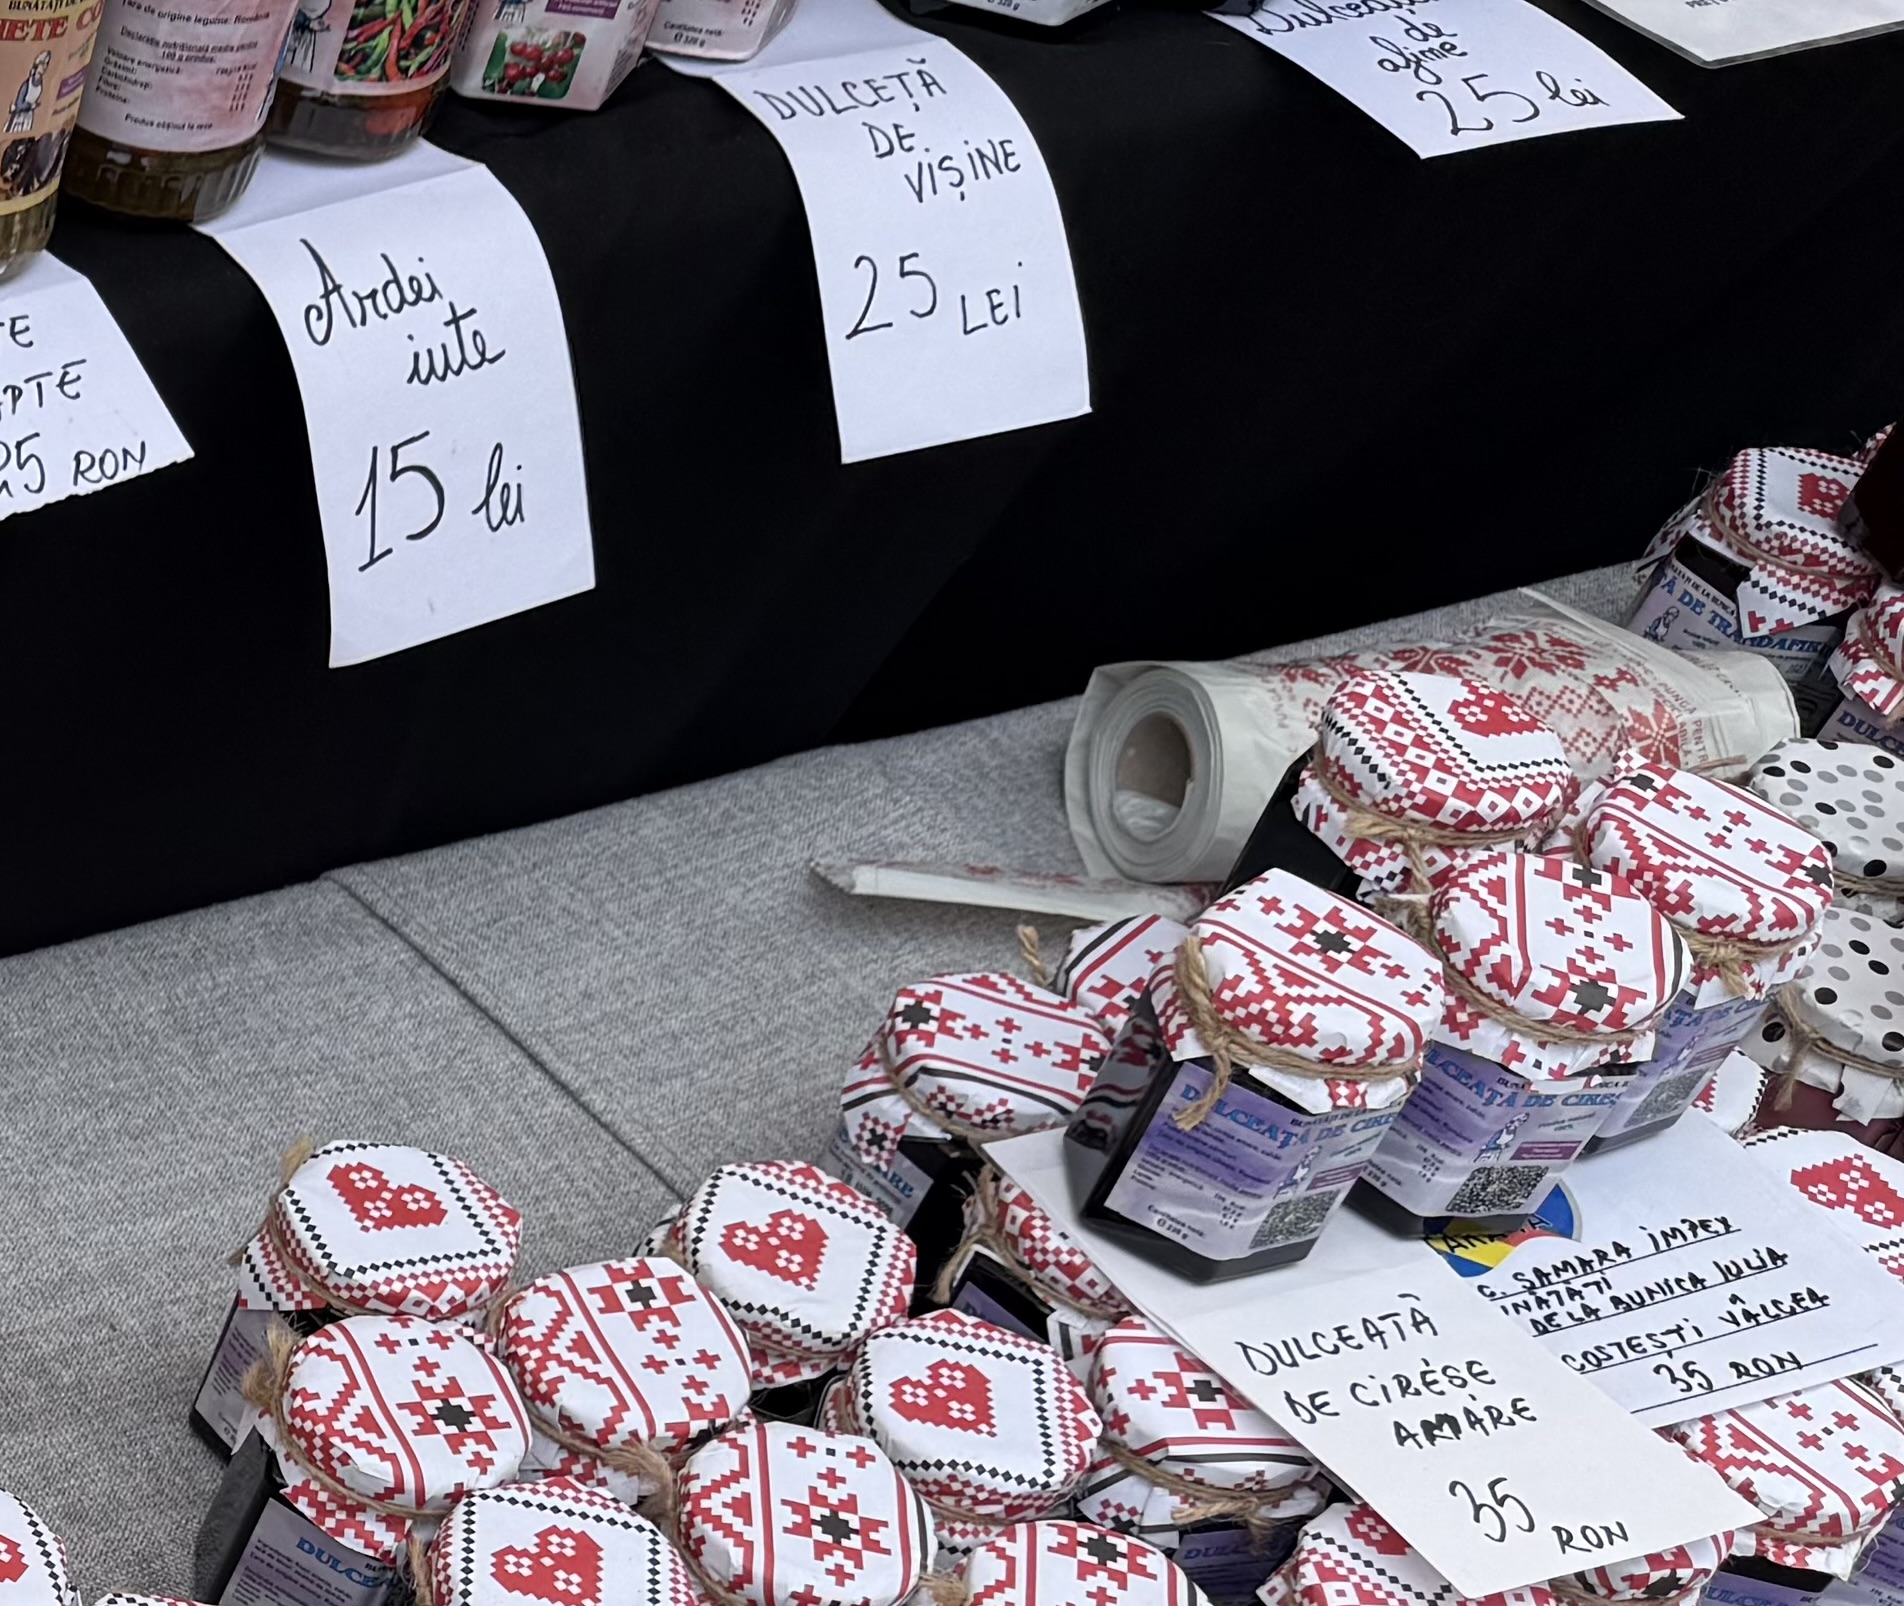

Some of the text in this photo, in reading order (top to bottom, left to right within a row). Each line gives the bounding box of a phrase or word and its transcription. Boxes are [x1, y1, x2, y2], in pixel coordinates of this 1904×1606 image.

[1416, 71, 1610, 136] 25 lei
[862, 122, 915, 158] DE
[300, 238, 443, 346] Ardei
[844, 251, 938, 341] 25
[407, 301, 506, 385] iute
[72, 444, 148, 486] RON
[355, 431, 524, 571] 15 lei
[1512, 1240, 1631, 1292] SAMARA
[1653, 1351, 1804, 1393] 35 RON
[1283, 1390, 1340, 1425] DE
[1446, 1475, 1536, 1544] 35
[1556, 1519, 1632, 1558] RON
